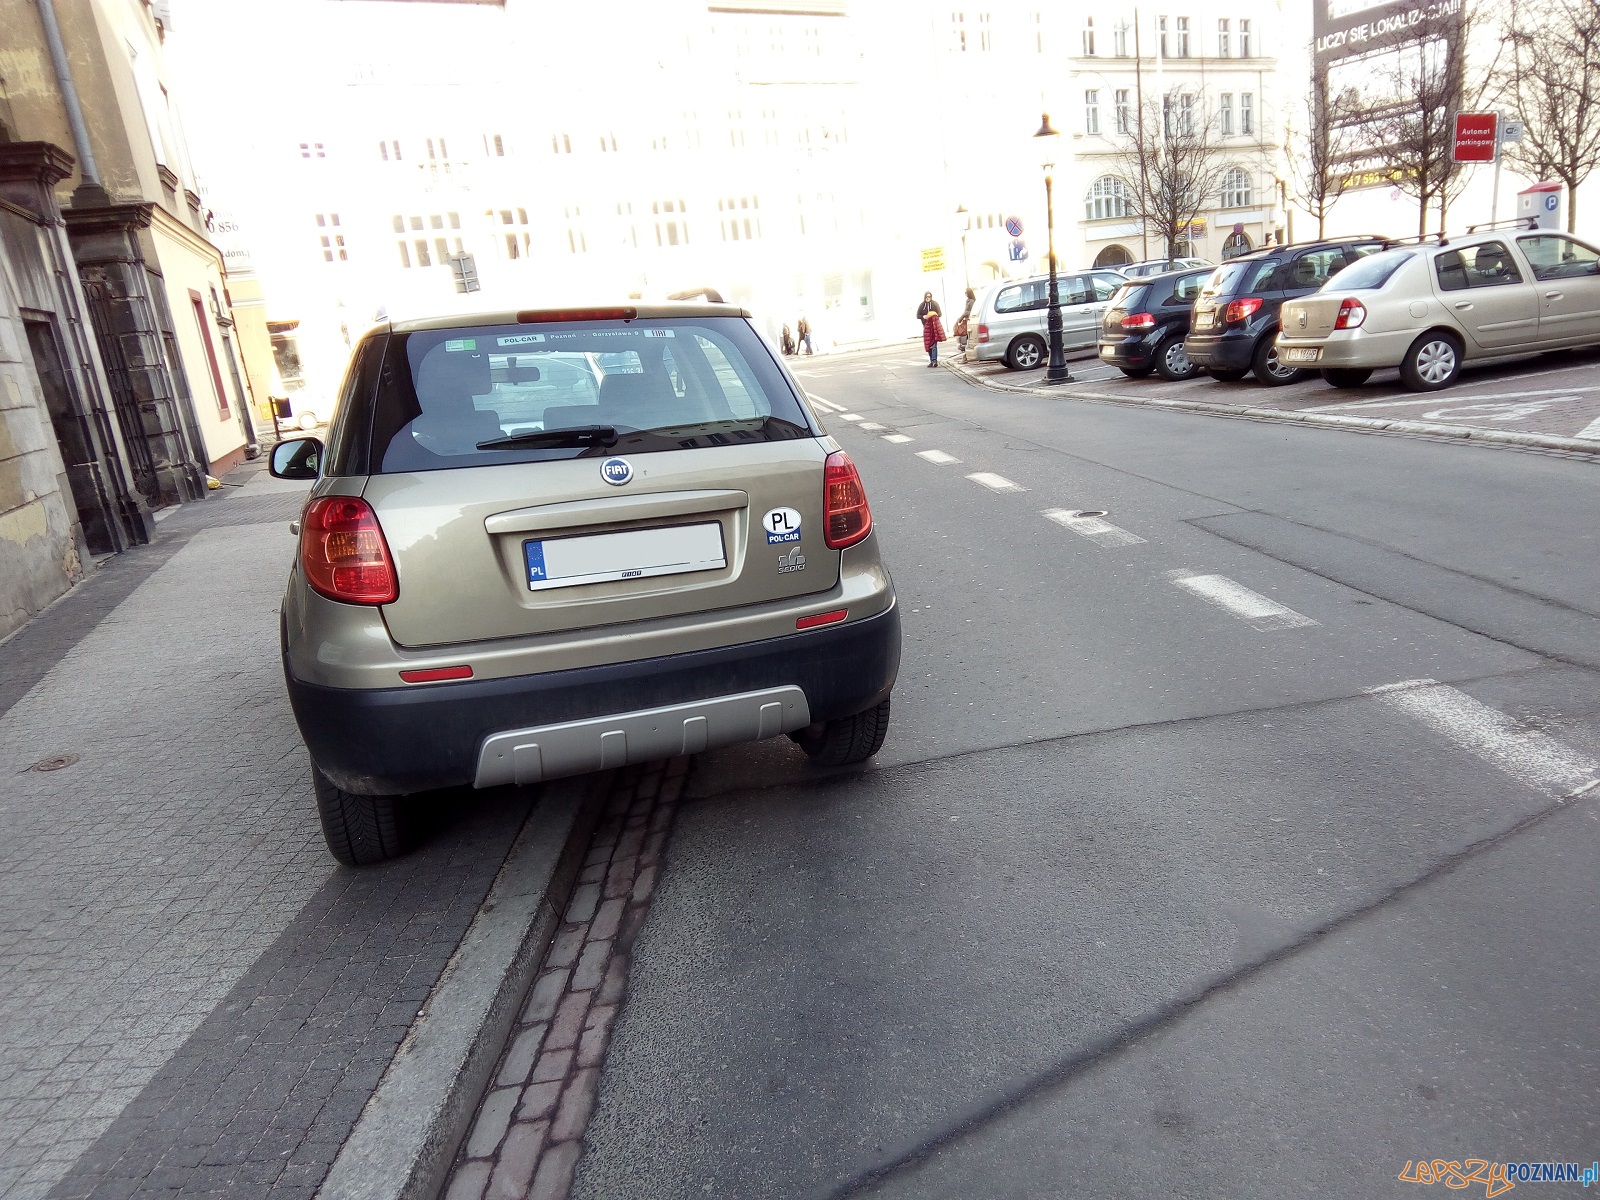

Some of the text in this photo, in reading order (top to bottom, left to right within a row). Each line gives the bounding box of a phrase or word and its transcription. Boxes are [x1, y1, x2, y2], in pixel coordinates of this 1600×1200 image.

[1317, 31, 1347, 51] LICZY
[1350, 24, 1369, 42] SIĘ
[1456, 139, 1494, 147] parkingowy
[218, 221, 239, 233] 856
[504, 336, 538, 344] POL-CAR
[605, 464, 628, 475] FIAT
[771, 511, 794, 531] PL
[530, 567, 544, 577] PL
[778, 563, 806, 574] SEDICI
